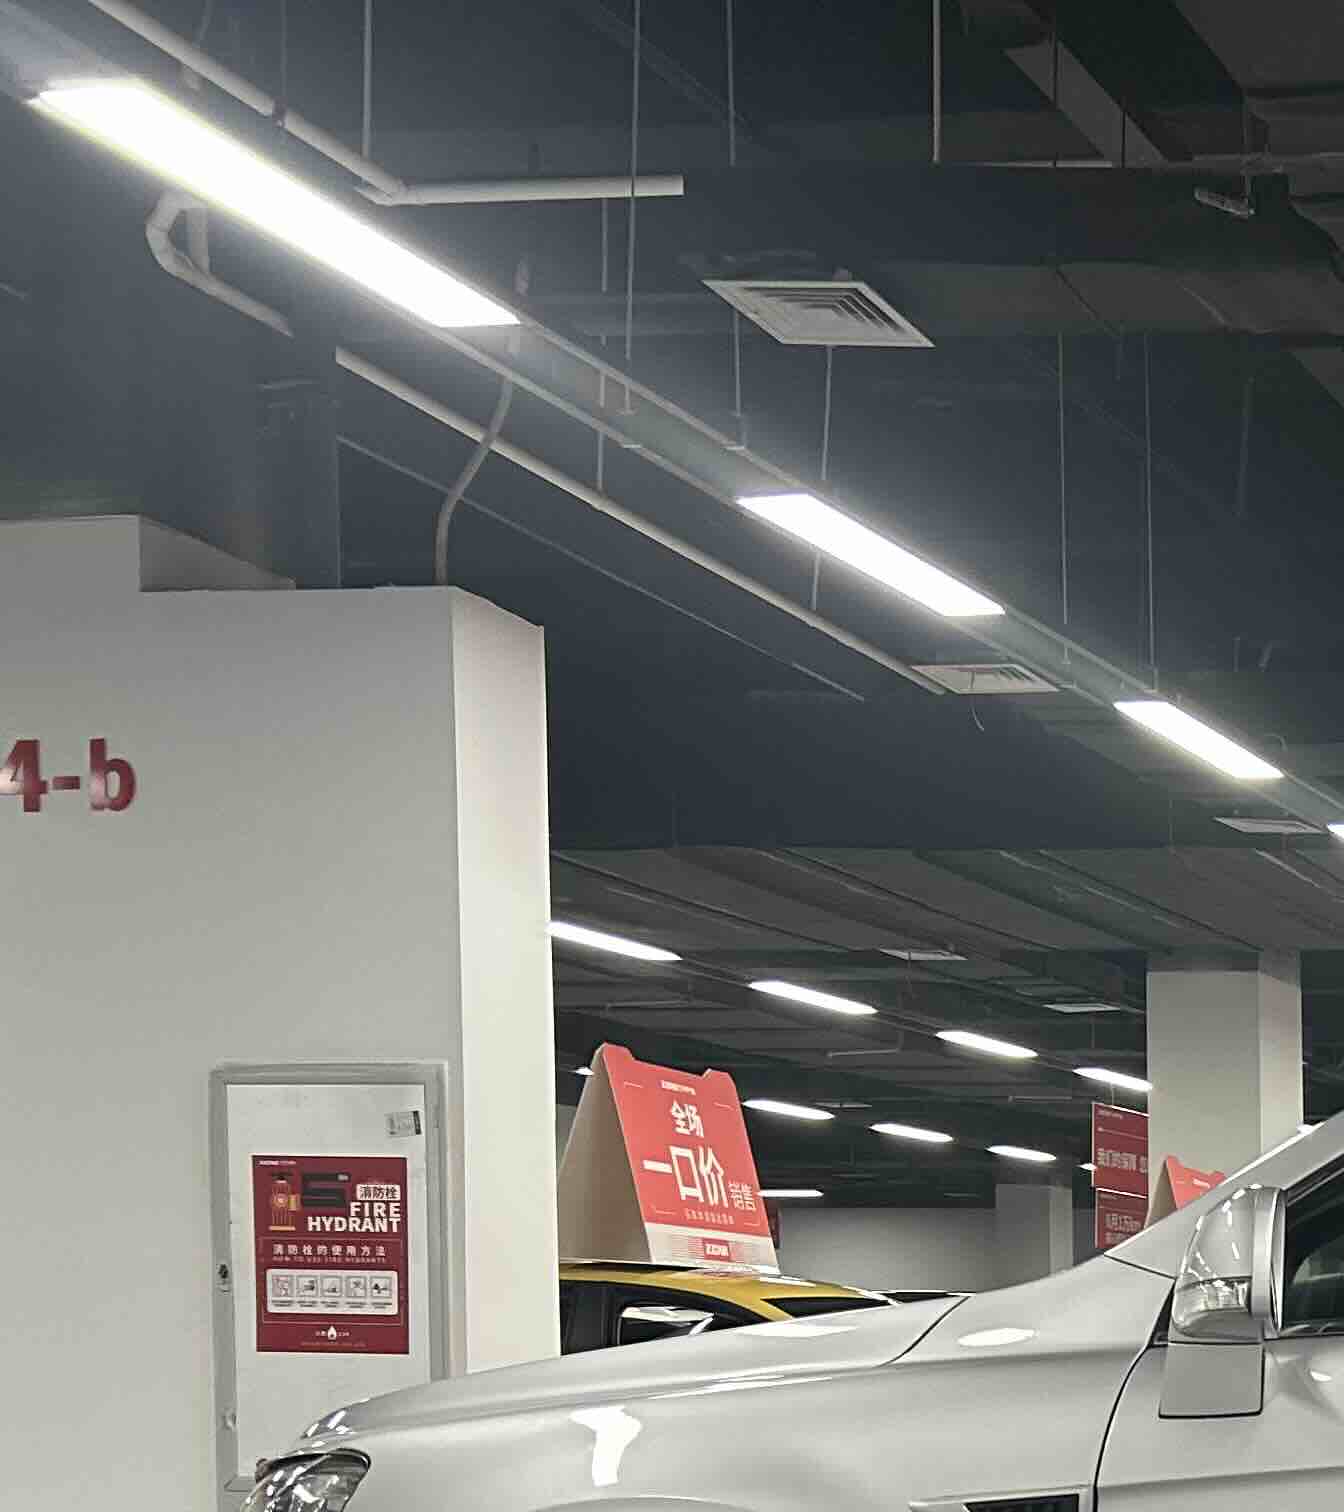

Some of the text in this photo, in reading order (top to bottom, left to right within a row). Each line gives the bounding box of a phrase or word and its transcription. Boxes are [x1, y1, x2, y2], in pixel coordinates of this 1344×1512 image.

[671, 1099, 705, 1138] 全场
[642, 1144, 730, 1209] 一口价
[359, 1185, 398, 1200] 消防栓
[350, 1202, 401, 1217] FIRE
[307, 1216, 401, 1233] HYDRANT
